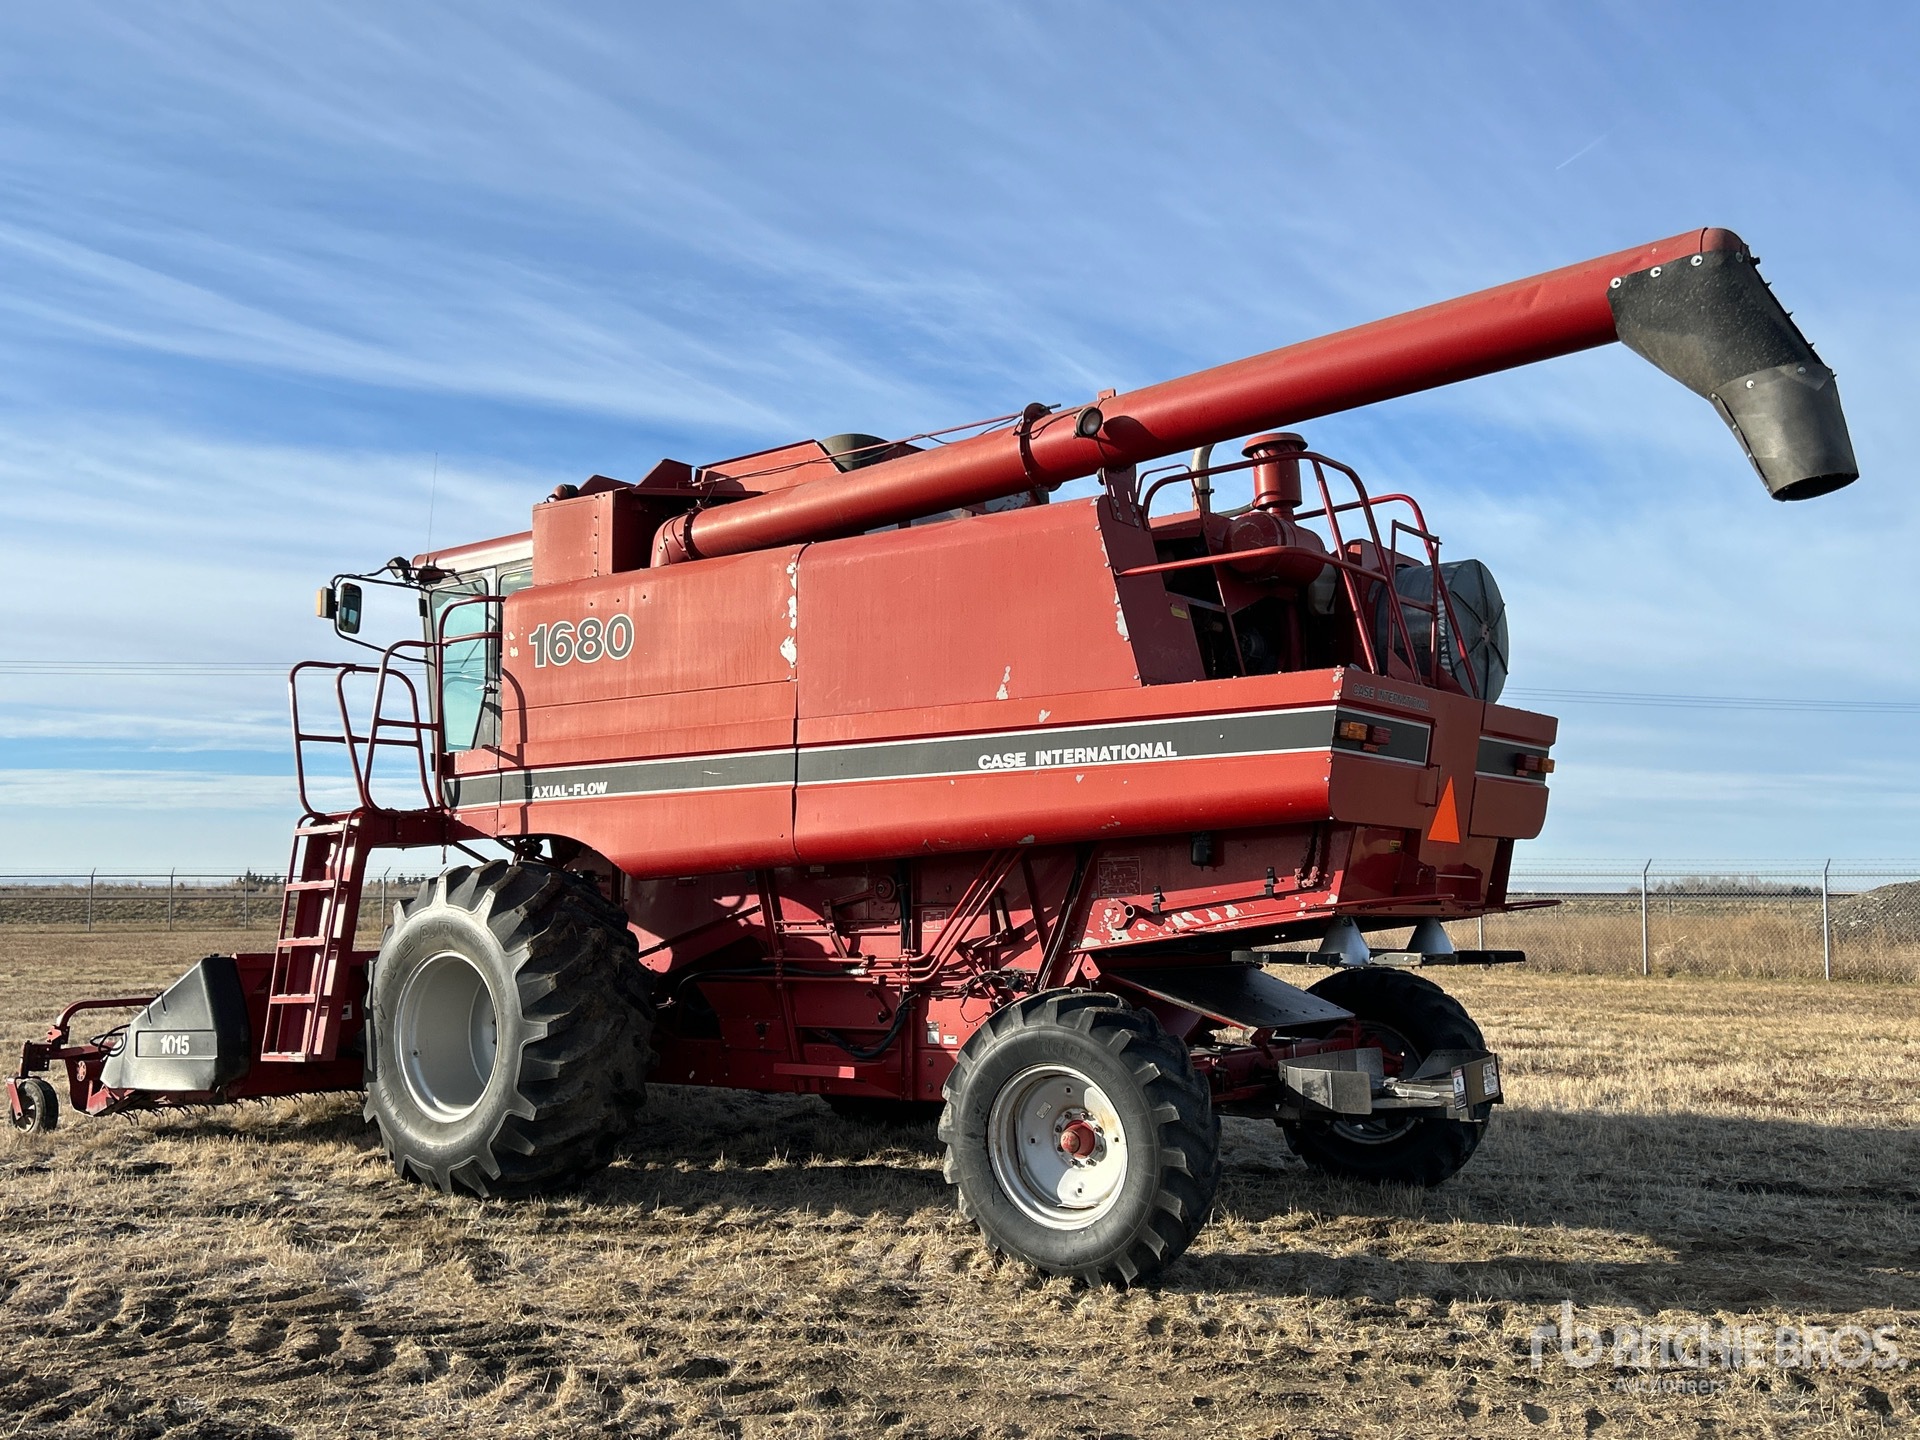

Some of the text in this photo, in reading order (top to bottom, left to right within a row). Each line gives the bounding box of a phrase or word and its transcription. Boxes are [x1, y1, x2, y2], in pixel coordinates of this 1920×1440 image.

[529, 613, 635, 668] 1680
[1352, 683, 1430, 711] CASE INTERNATIONAL
[978, 741, 1178, 770] CASE INTERNATIONAL
[532, 781, 608, 799] AXIAL-FLOW
[160, 1034, 190, 1055] 1015
